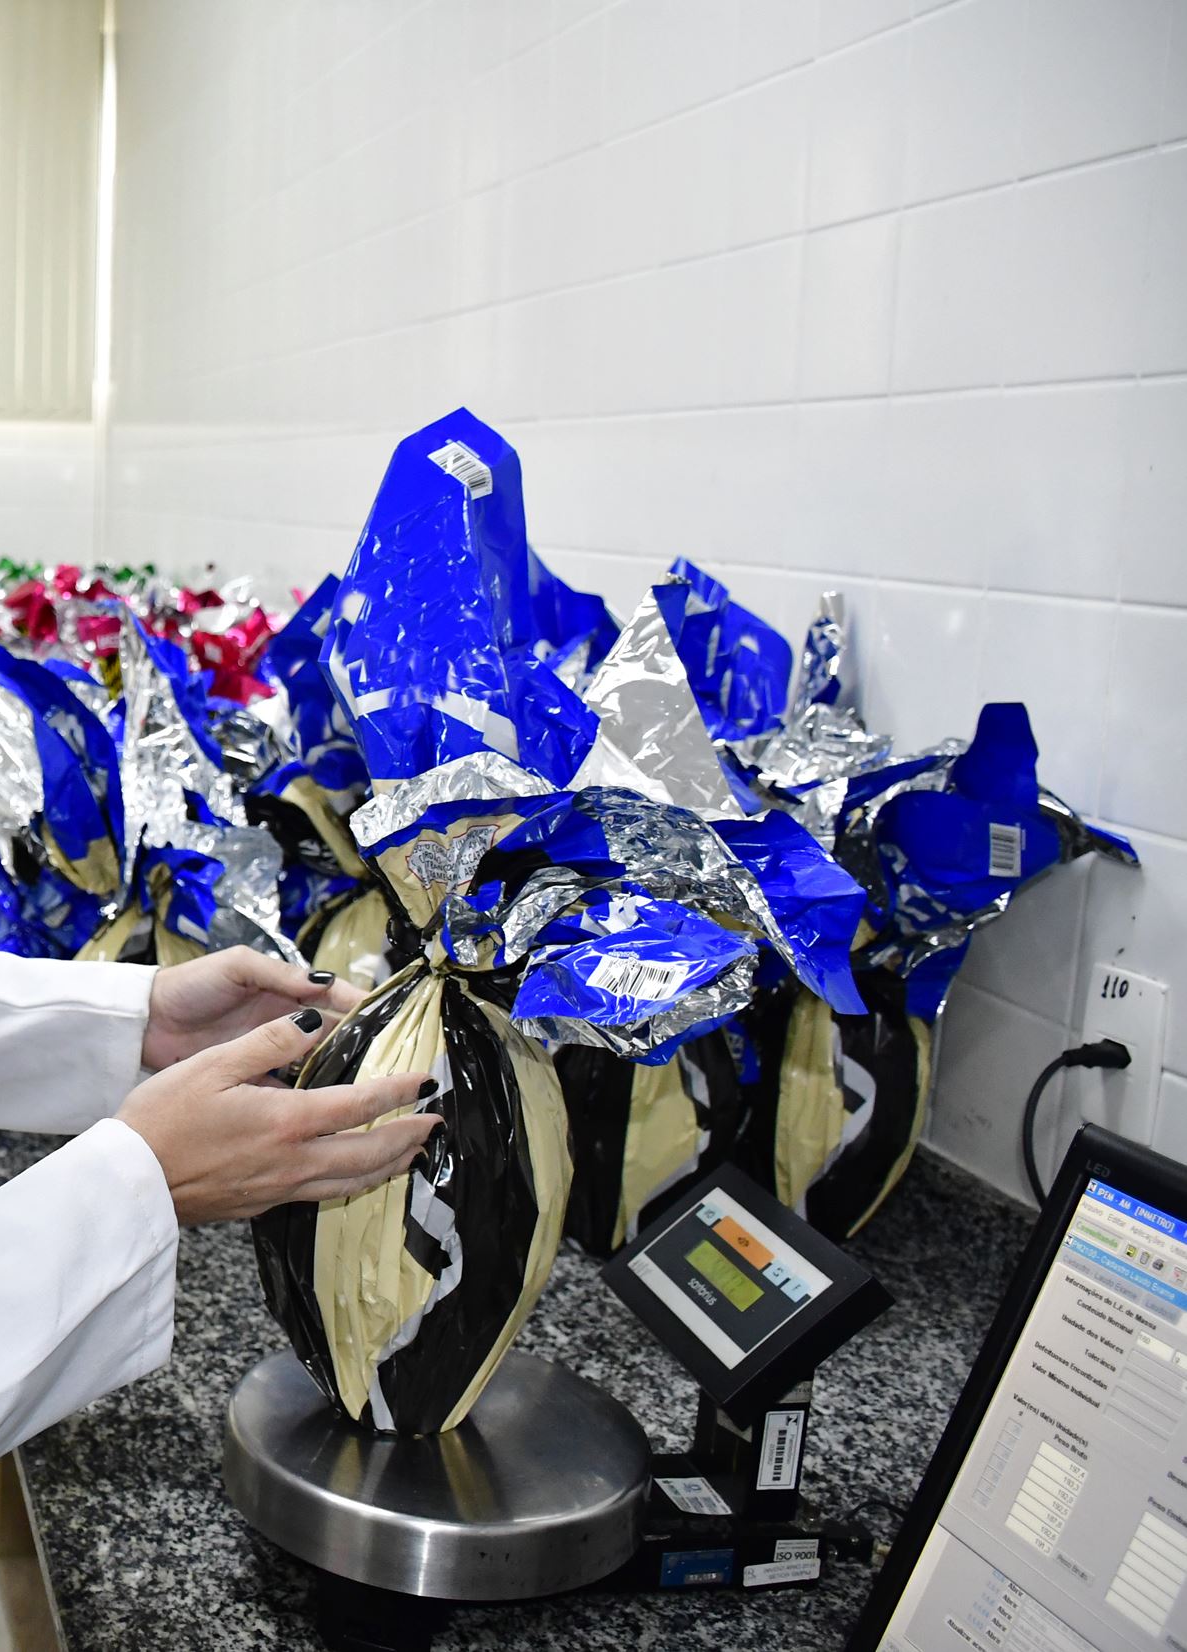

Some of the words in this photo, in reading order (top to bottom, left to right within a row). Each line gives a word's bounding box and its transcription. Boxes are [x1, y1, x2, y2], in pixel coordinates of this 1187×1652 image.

[1101, 974, 1129, 998] 110
[1085, 1160, 1111, 1177] LED
[1097, 1187, 1114, 1202] IPEM
[1119, 1198, 1131, 1210] AM
[1134, 1206, 1175, 1233] [INMETRO]
[687, 1277, 718, 1307] sartorius
[1065, 1275, 1103, 1300] Informações
[1135, 1313, 1157, 1330] Massa
[1062, 1313, 1086, 1332] Unidade
[1086, 1328, 1099, 1340] dos
[1100, 1336, 1124, 1355] Valores
[1107, 1316, 1134, 1335] Nominal
[1034, 1341, 1069, 1367] Defeituosas
[1069, 1362, 1108, 1390] Encontradas
[1032, 1361, 1047, 1375] Valor
[1070, 1386, 1100, 1408] Individual
[1053, 1433, 1070, 1449] Peso
[1070, 1443, 1088, 1461] Bruto
[1056, 1418, 1088, 1448] Unidade(s)
[776, 1551, 792, 1560] ISO
[794, 1551, 816, 1560] 9001
